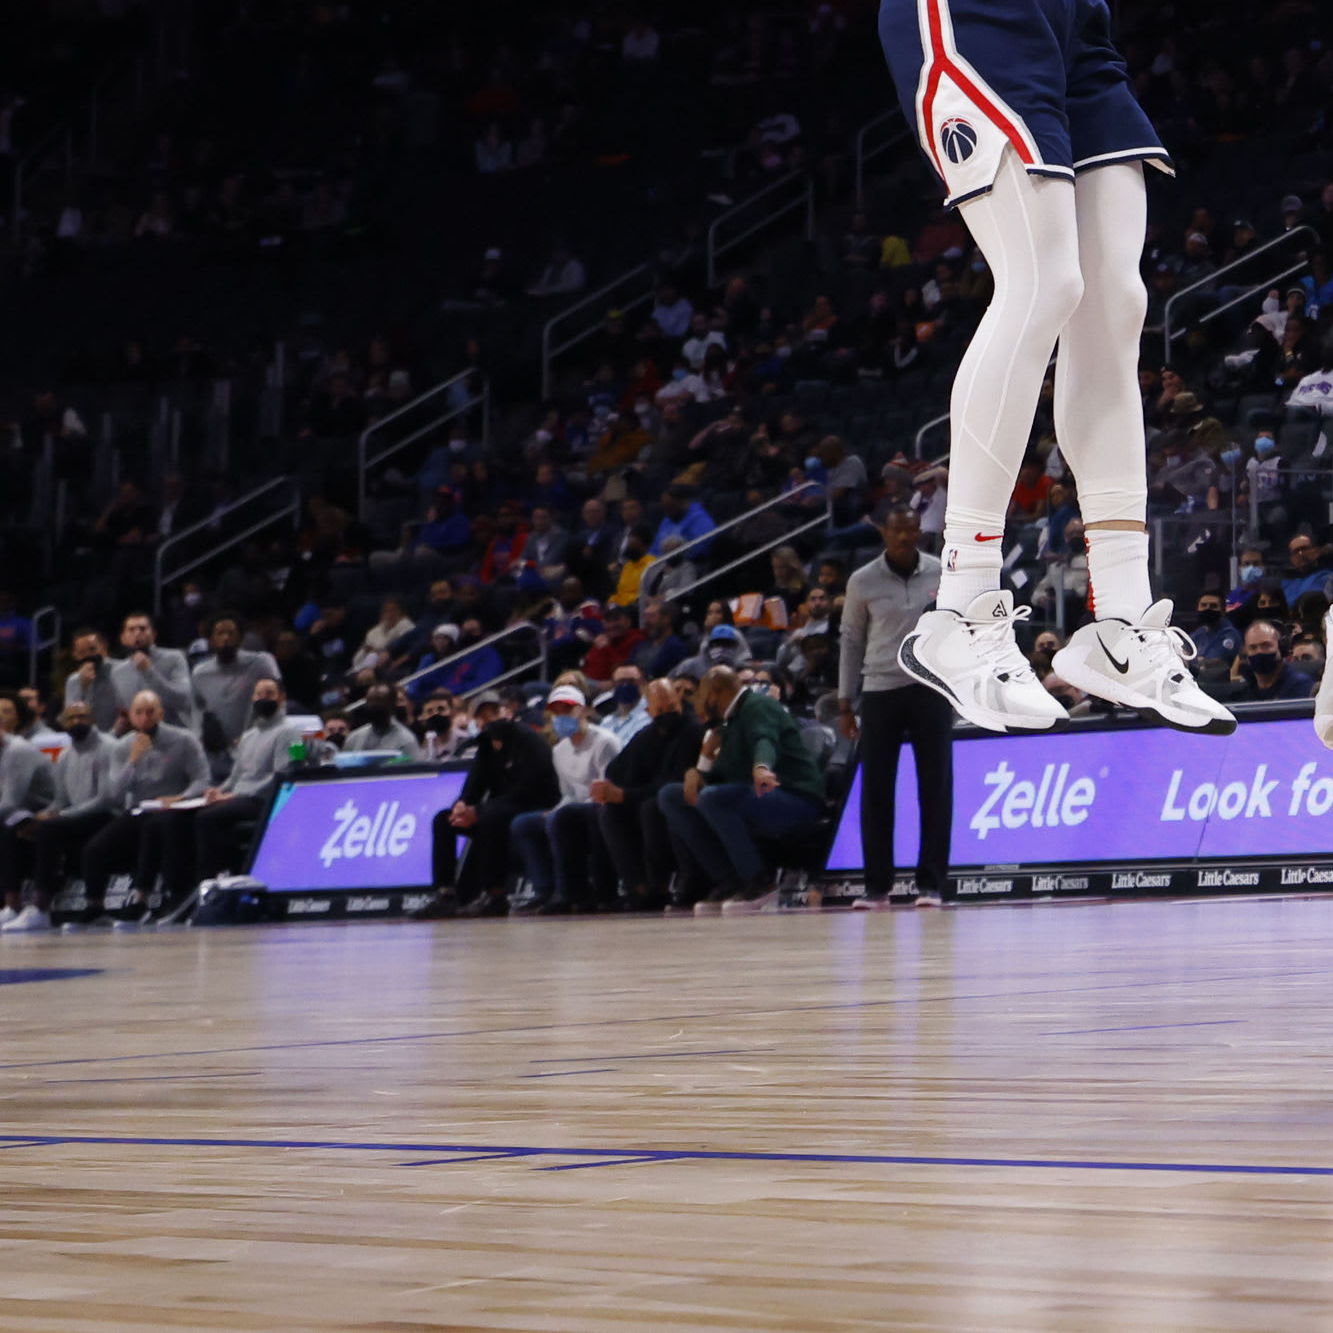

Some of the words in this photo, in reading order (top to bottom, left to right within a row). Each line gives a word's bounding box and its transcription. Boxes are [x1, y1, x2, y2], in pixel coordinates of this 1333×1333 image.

[969, 761, 1096, 840] Zelle
[1160, 764, 1279, 822] Look
[319, 799, 416, 868] Zelle
[1198, 870, 1223, 887] Little
[1222, 869, 1259, 886] Caesars
[1281, 868, 1306, 884] Little
